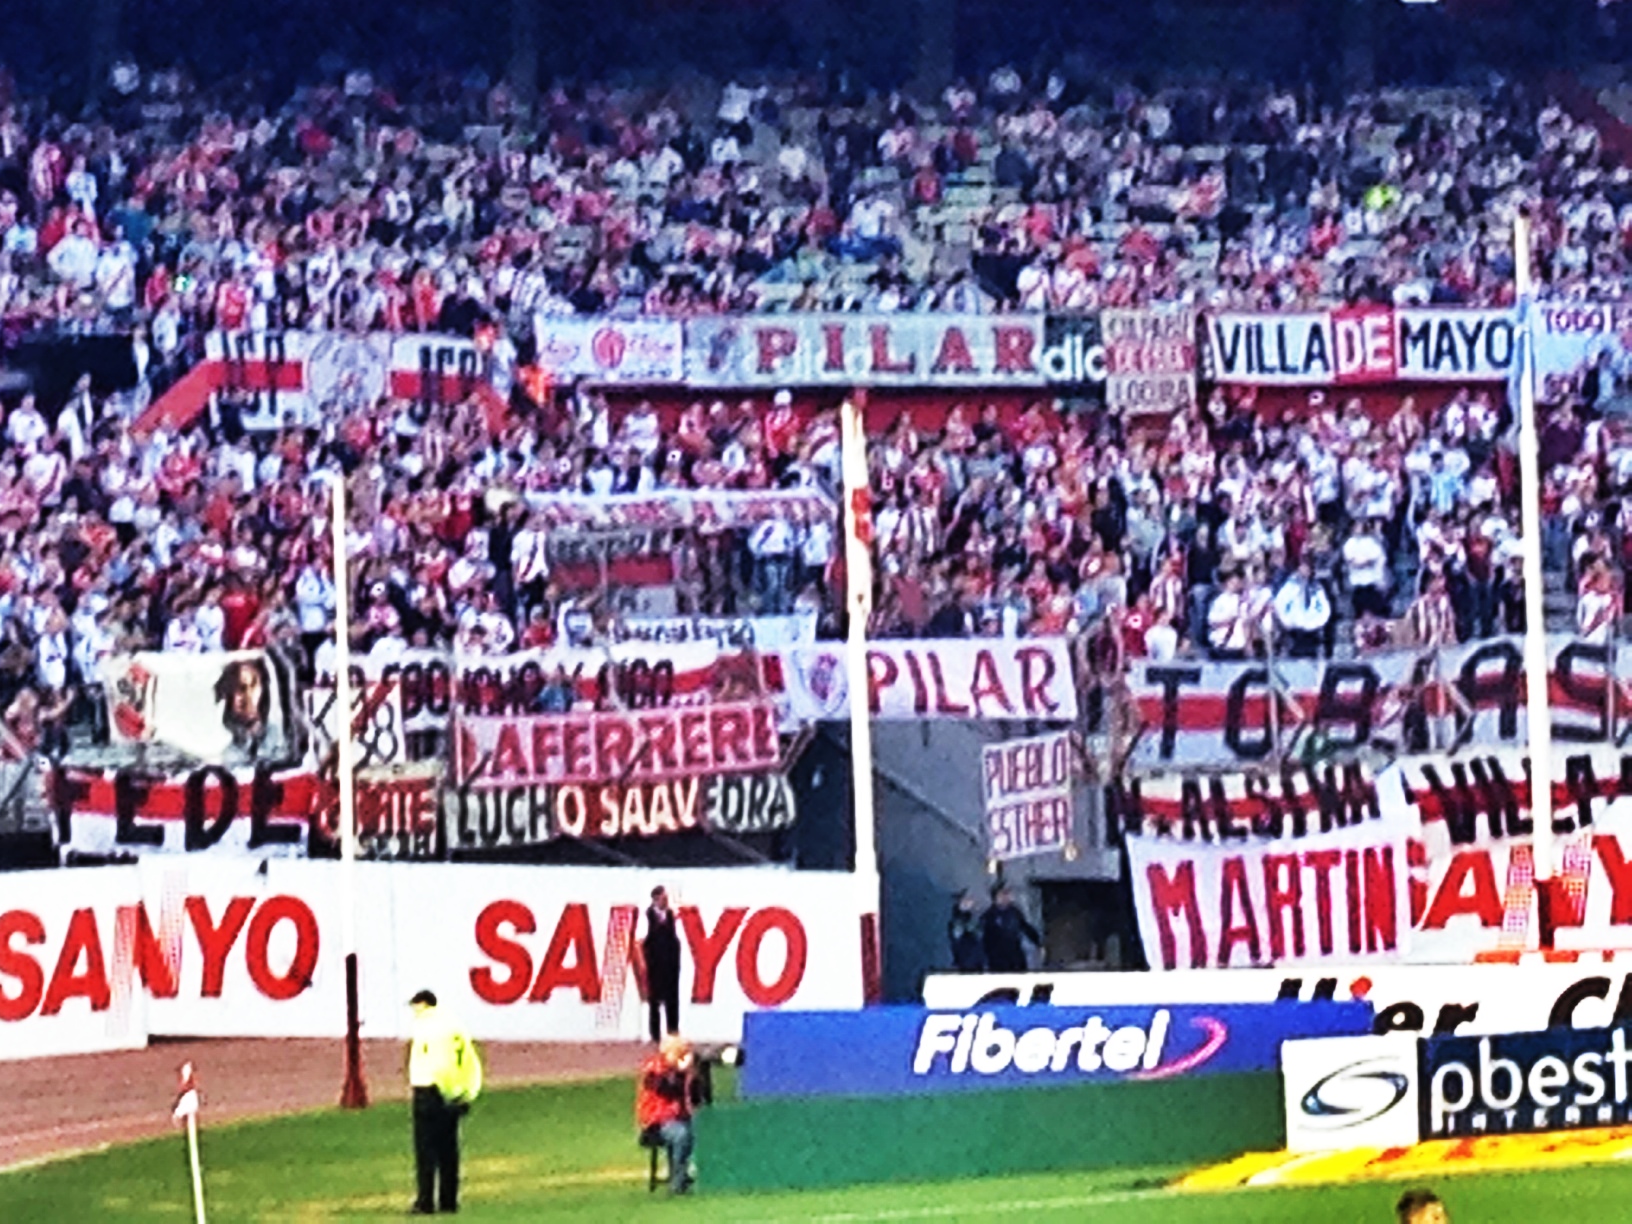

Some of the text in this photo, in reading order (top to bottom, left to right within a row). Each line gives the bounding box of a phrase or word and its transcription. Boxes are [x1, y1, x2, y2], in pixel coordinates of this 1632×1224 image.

[755, 322, 1039, 375] PILAR
[1215, 319, 1330, 376] VILLA
[1336, 316, 1395, 369] DE
[1401, 317, 1515, 375] MAYO
[866, 647, 1060, 718] PILAR
[457, 783, 586, 846] LUCHO
[599, 774, 798, 838] SAAVEDRA
[1146, 842, 1399, 971] MARTIN
[912, 1008, 1171, 1075] Fibertel
